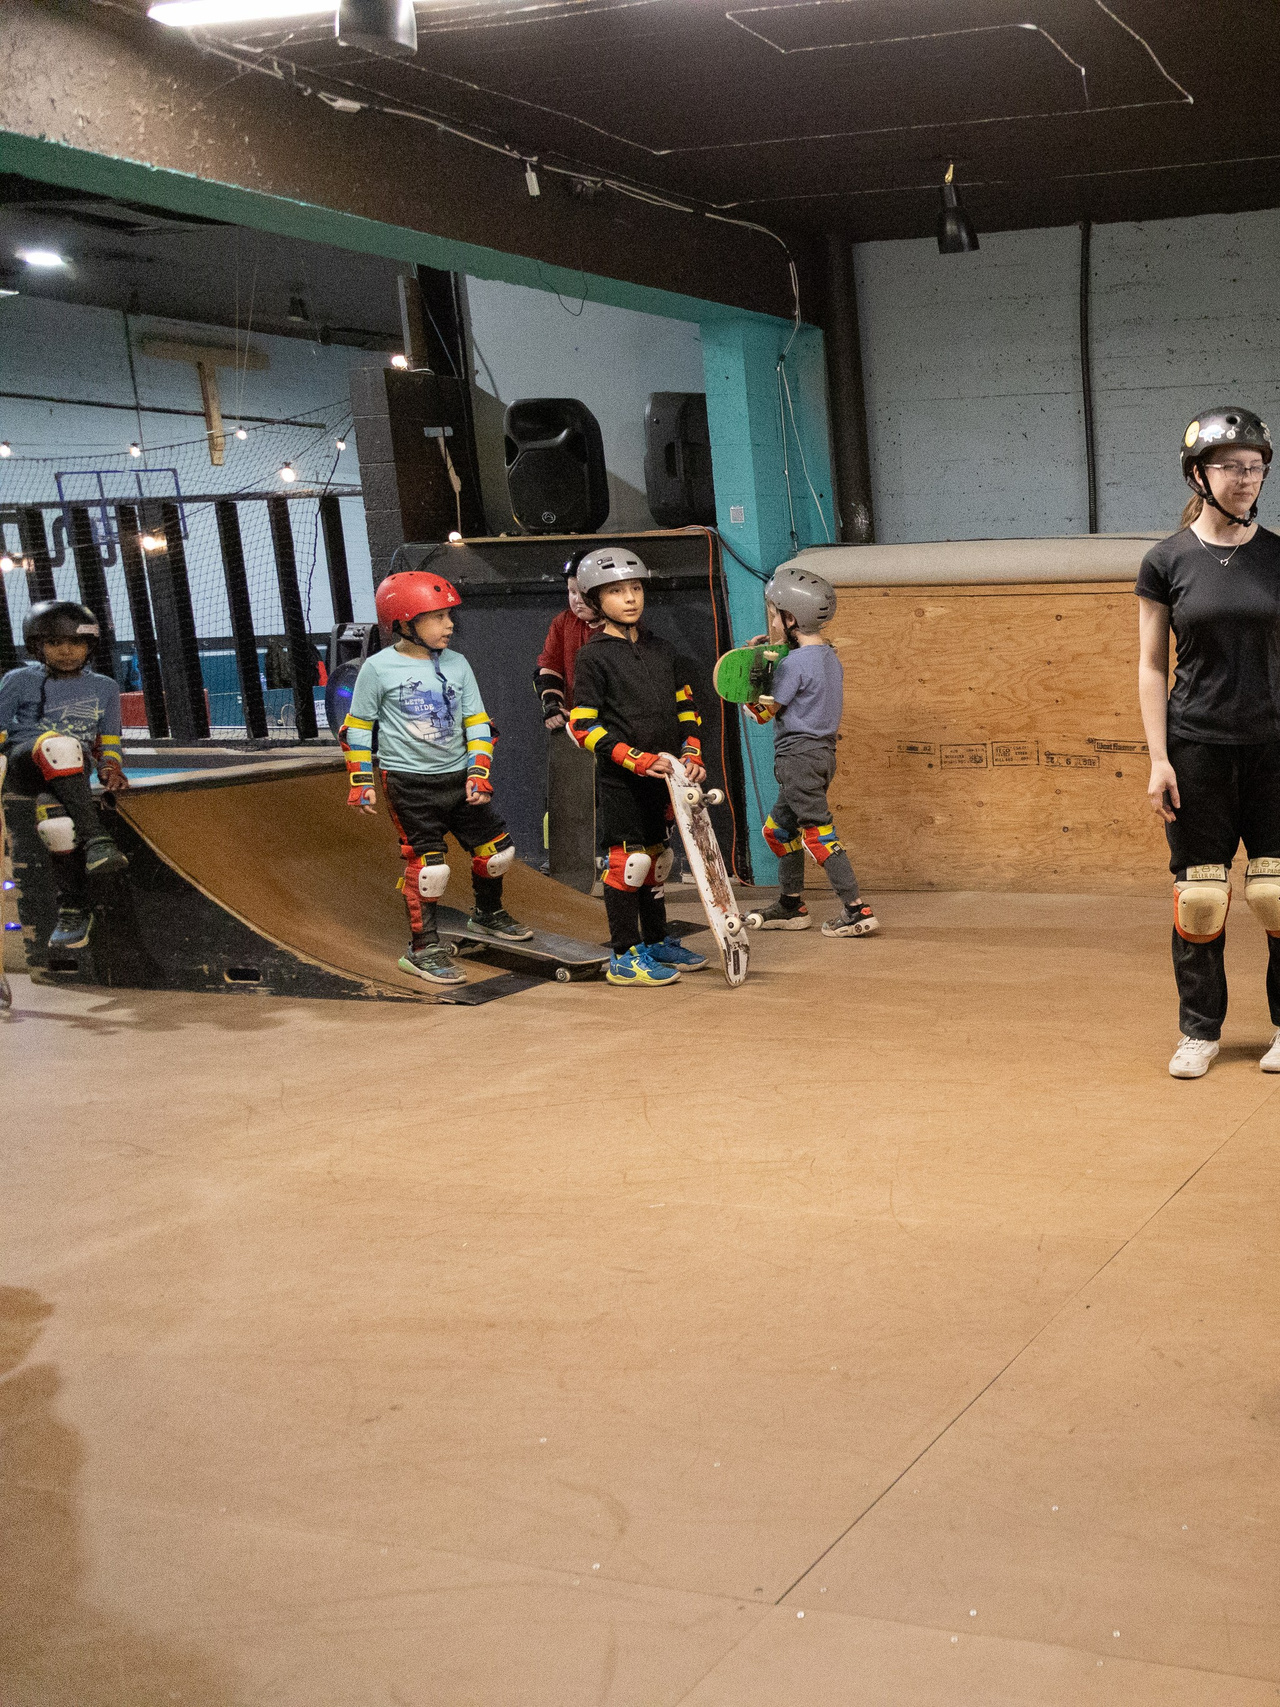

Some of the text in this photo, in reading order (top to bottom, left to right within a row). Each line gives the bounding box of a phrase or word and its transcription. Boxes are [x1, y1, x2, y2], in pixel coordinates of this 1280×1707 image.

[414, 703, 435, 712] RIDE
[1254, 860, 1280, 868] 187
[1193, 865, 1220, 873] 187
